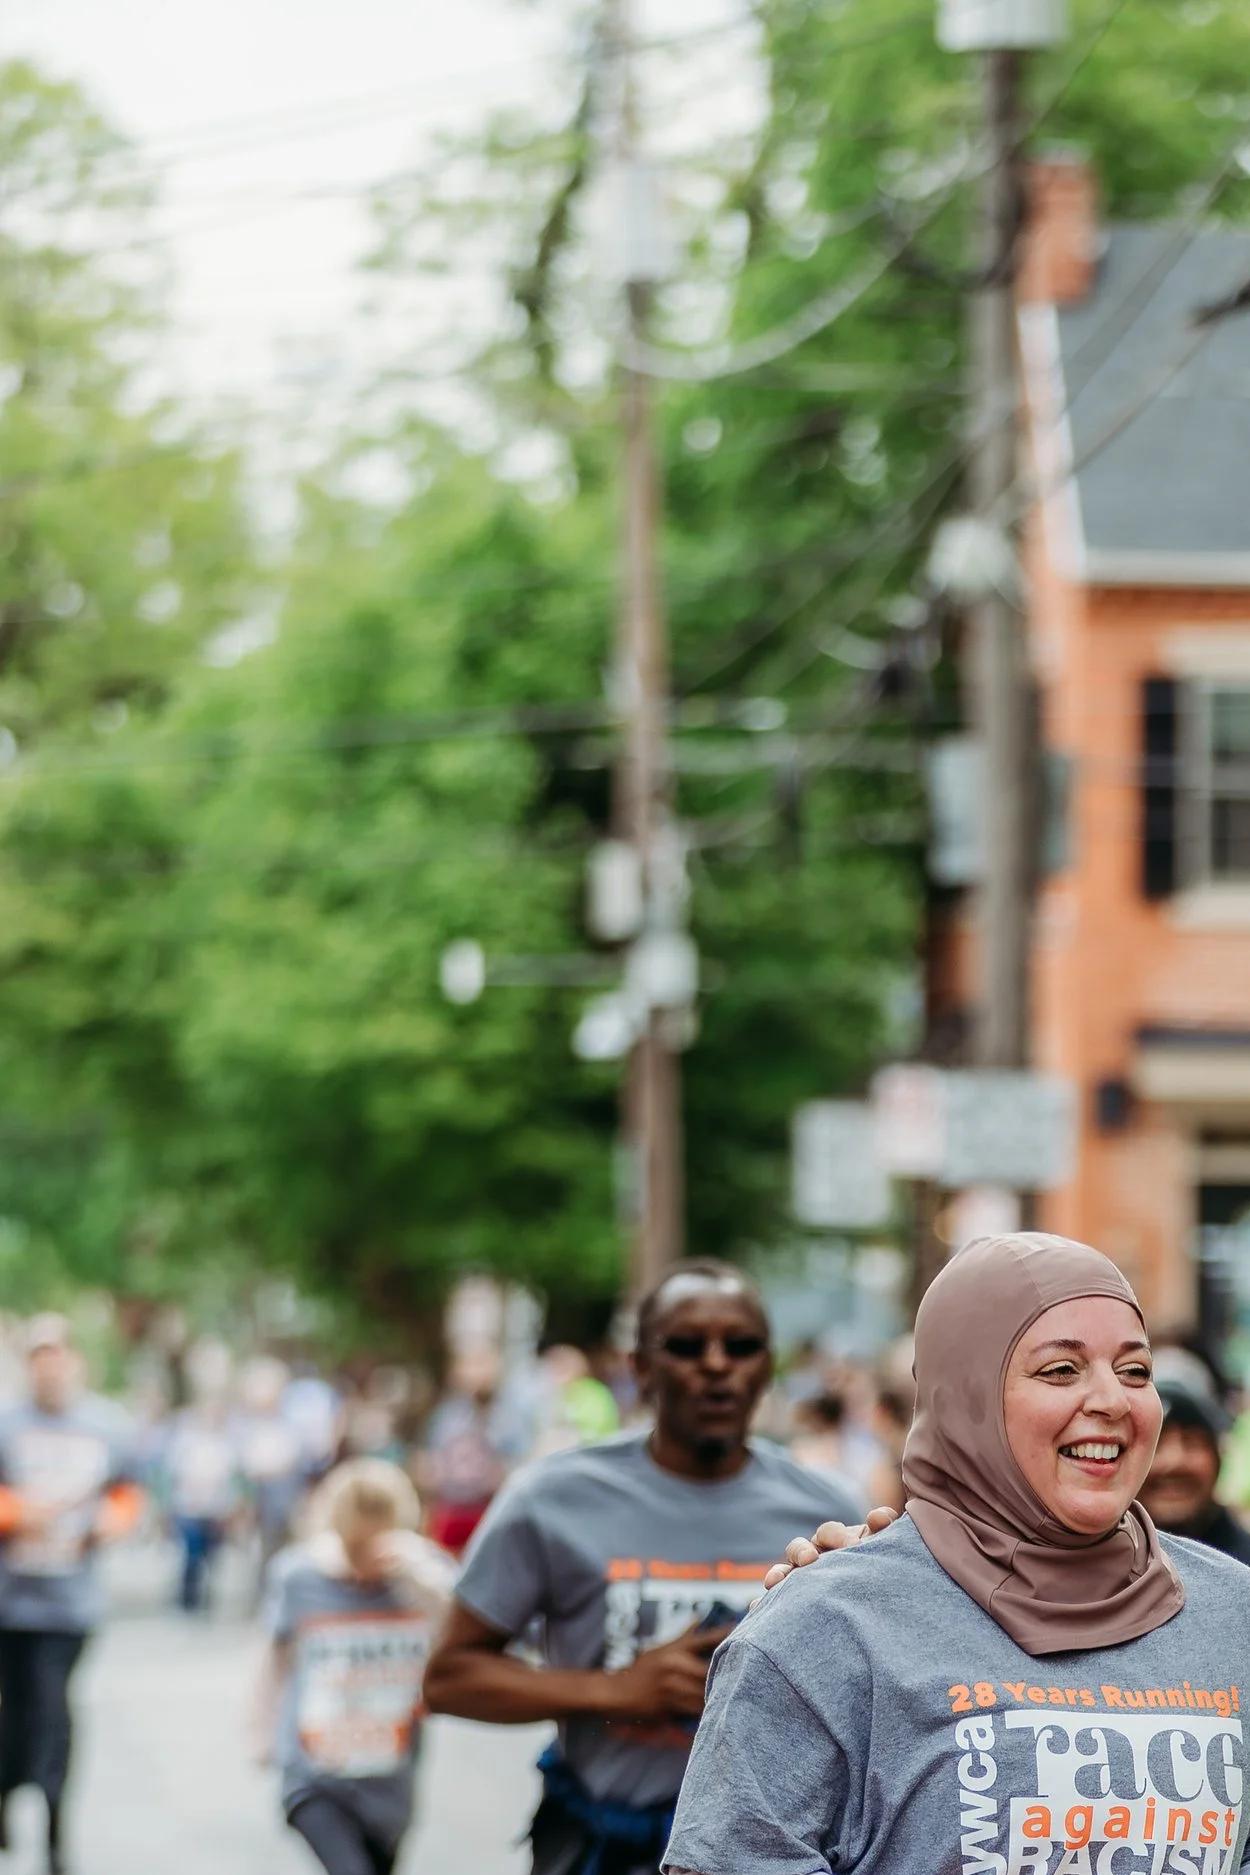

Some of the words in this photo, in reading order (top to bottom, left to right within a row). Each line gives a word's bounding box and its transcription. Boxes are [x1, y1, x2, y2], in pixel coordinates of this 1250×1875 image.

[948, 1682, 997, 1713] 28
[1002, 1680, 1097, 1707] Years
[1100, 1681, 1240, 1718] Running!
[1006, 1724, 1244, 1807] race
[1021, 1797, 1235, 1850] against
